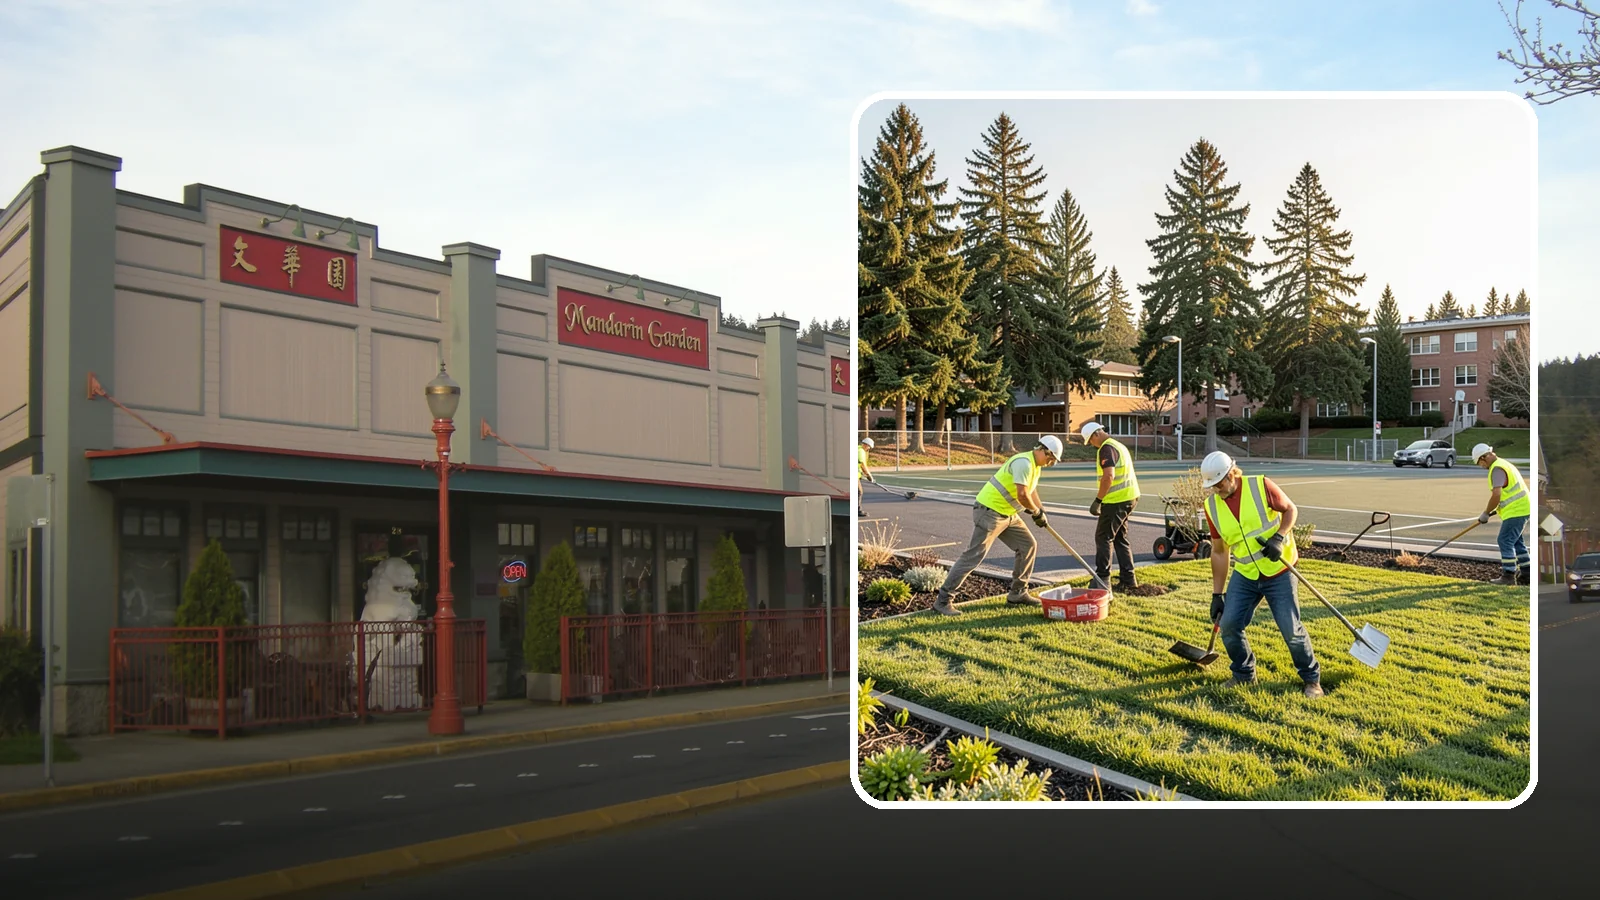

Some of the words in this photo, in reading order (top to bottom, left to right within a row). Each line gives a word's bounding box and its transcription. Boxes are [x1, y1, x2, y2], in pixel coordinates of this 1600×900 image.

[231, 235, 347, 291] 文華園
[564, 302, 644, 341] Mandarin
[647, 320, 702, 352] Garden
[503, 565, 527, 578] OPEN
